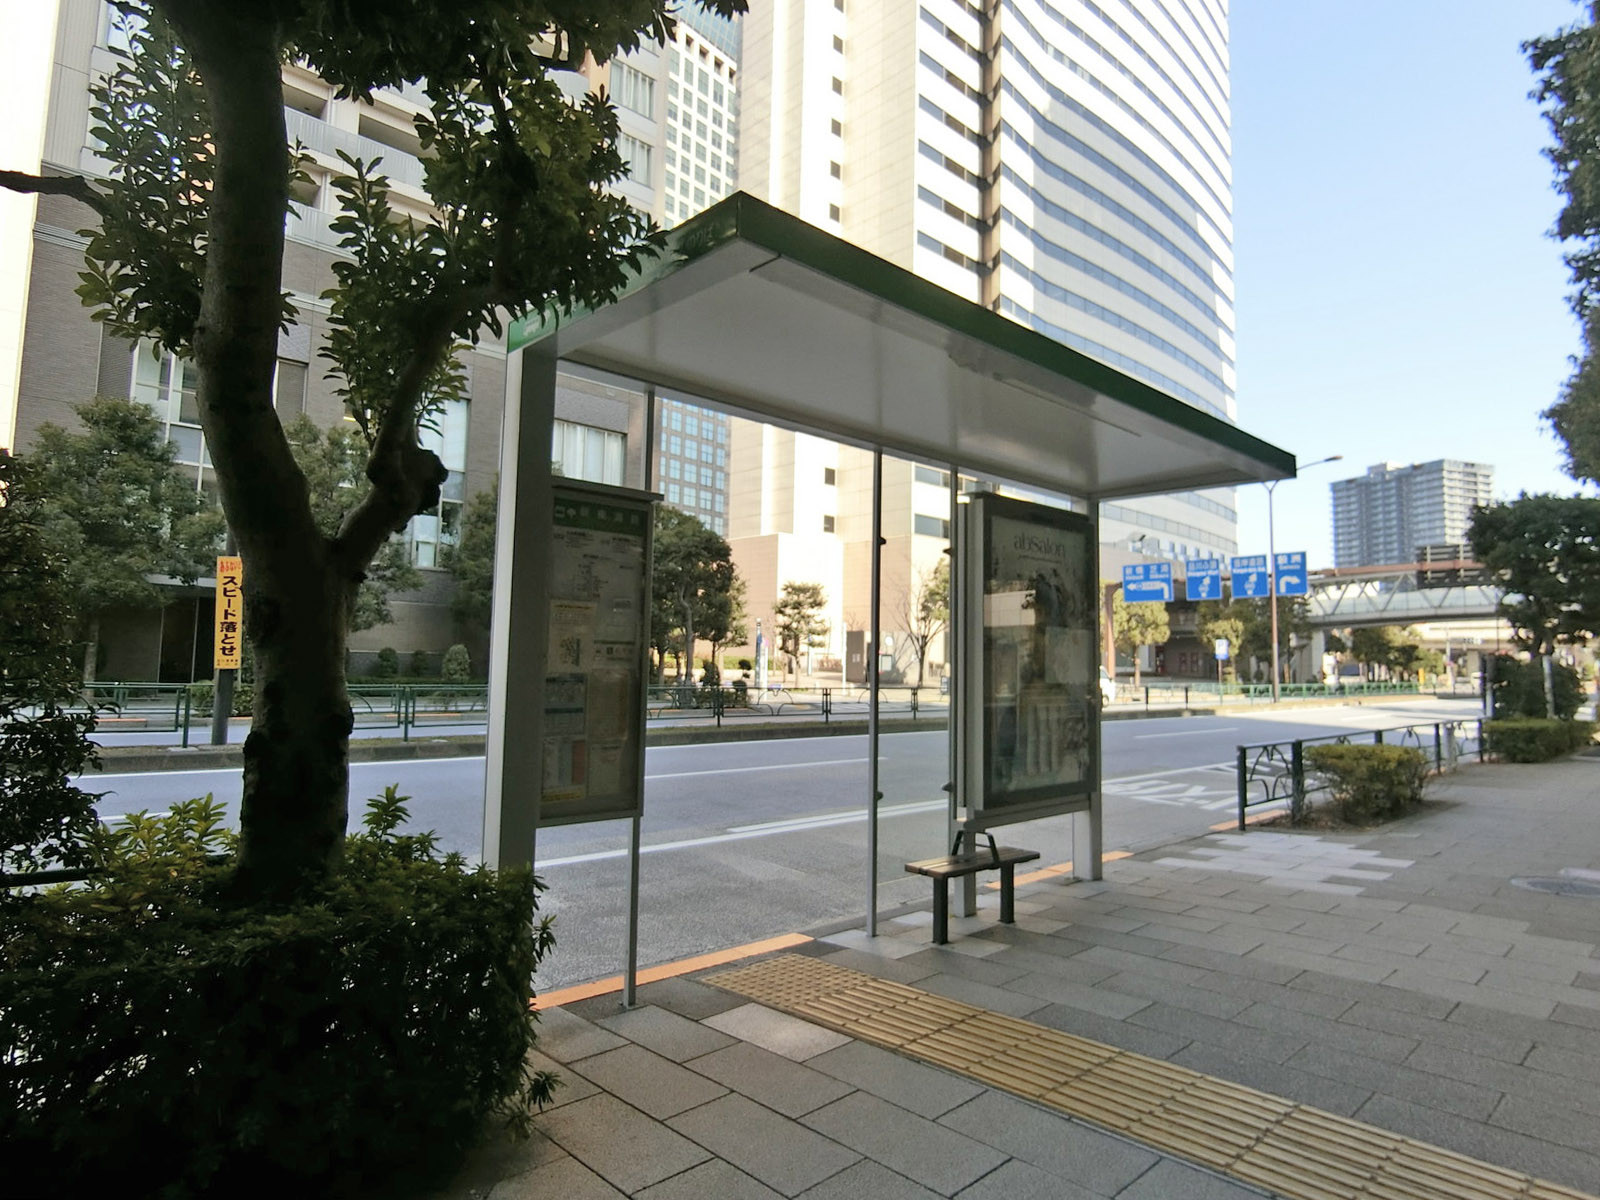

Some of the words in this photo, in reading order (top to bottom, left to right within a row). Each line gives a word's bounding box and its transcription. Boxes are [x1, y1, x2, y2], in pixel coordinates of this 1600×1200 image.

[219, 576, 239, 656] スピード落とせ
